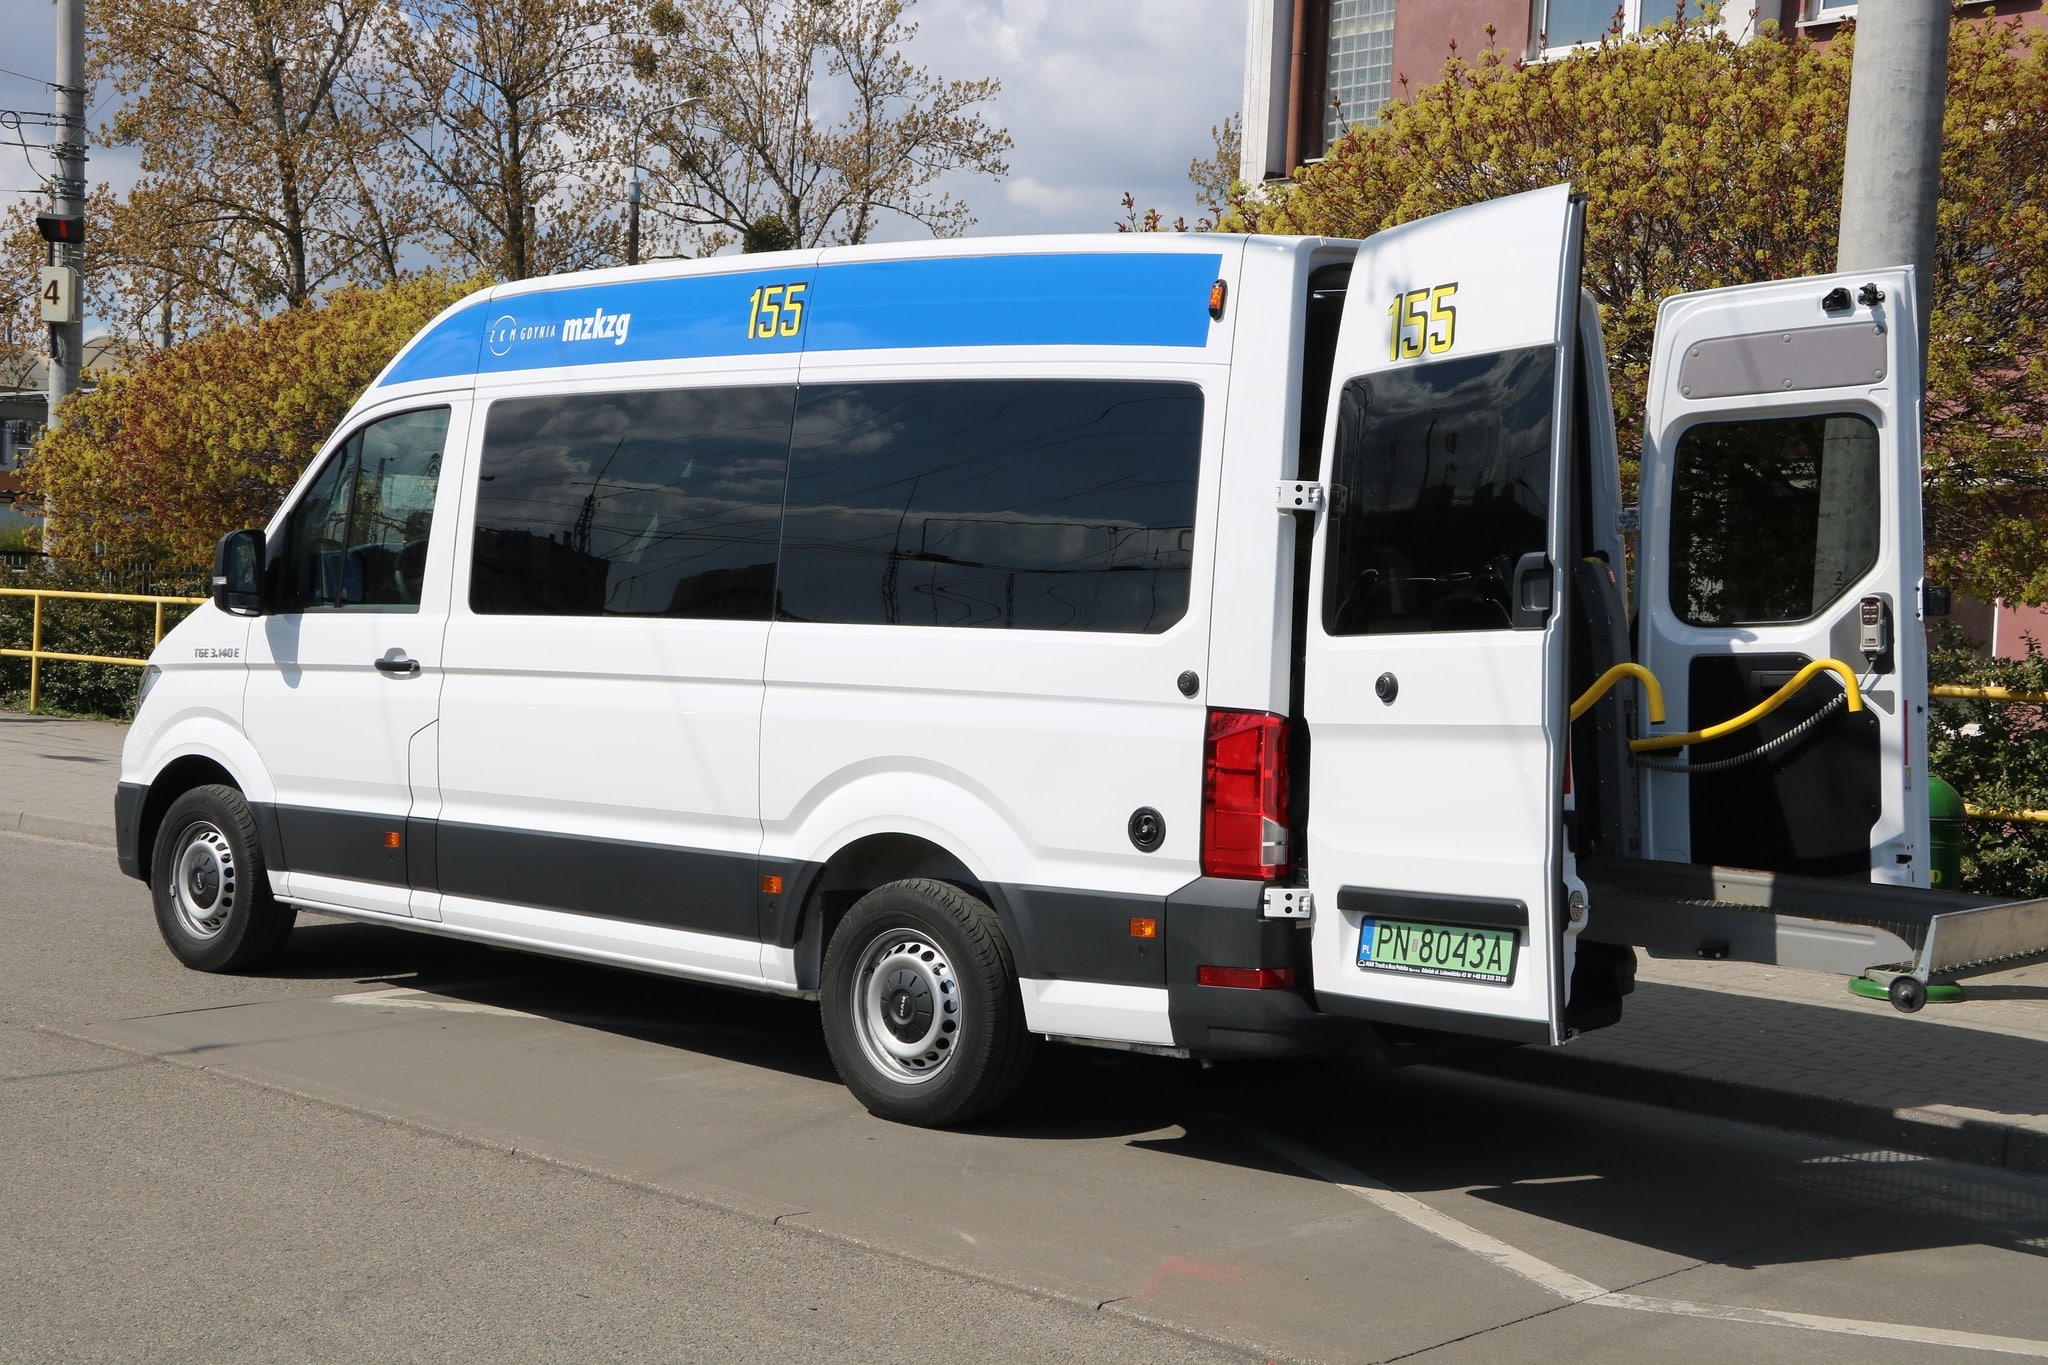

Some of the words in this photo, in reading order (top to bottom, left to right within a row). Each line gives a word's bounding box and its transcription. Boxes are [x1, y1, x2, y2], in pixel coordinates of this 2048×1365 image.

[43, 279, 61, 306] 4
[562, 307, 631, 346] mzkzg
[747, 281, 808, 340] 155
[1387, 282, 1459, 362] 155
[520, 324, 556, 341] GDYNIA
[194, 648, 209, 658] TGE
[210, 648, 233, 658] 3.140
[234, 648, 240, 658] E
[1361, 944, 1370, 954] PL
[1376, 924, 1411, 961] PN
[1419, 928, 1502, 971] 8043A
